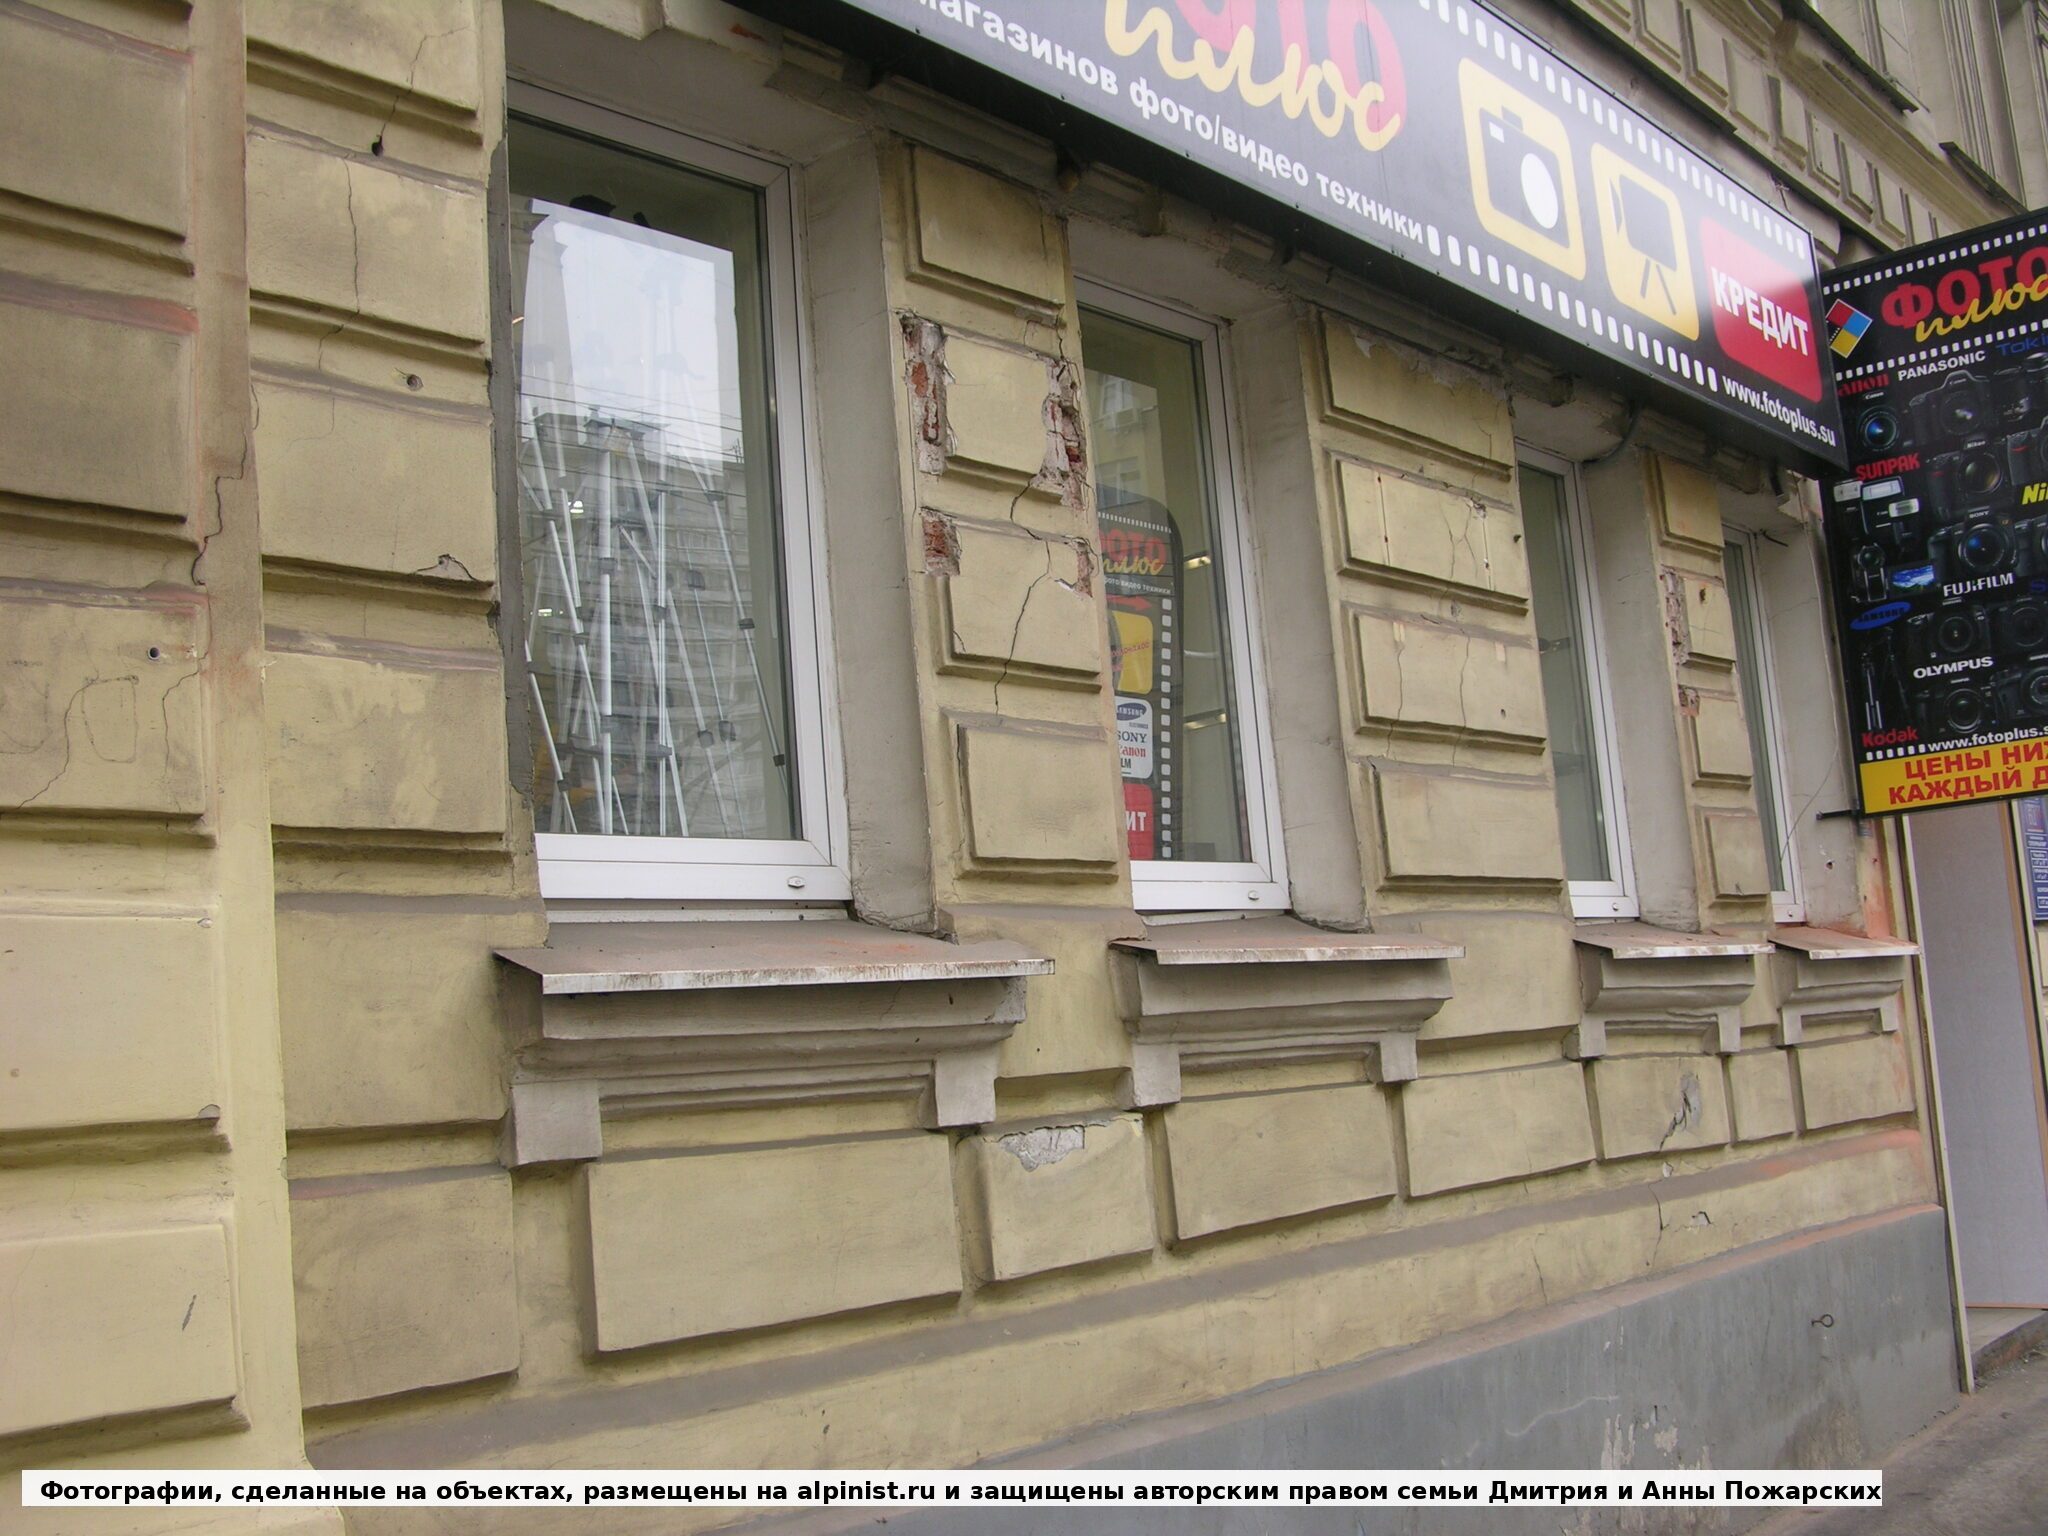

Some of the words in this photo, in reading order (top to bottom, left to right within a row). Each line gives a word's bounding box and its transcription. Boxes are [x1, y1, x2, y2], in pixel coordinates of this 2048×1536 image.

[1129, 76, 1309, 187] фото/видео
[1315, 171, 1424, 245] техники
[1881, 246, 2048, 330] ФОТО
[1711, 266, 1809, 357] КРЕДИТ
[1994, 333, 2048, 357] Toki
[1897, 350, 1986, 382] PANASONIC
[1722, 374, 1837, 448] www.fotoplus.su
[1856, 453, 1920, 482] SUNPAK
[2021, 482, 2048, 505] Ni
[1943, 572, 2014, 597] FUJIFILM
[1913, 656, 1994, 679] OLYMPUS
[1862, 726, 1919, 748] Kodak
[1905, 750, 1992, 781] ЦЕНЫ
[1888, 765, 2023, 805] КАЖДЫЙ
